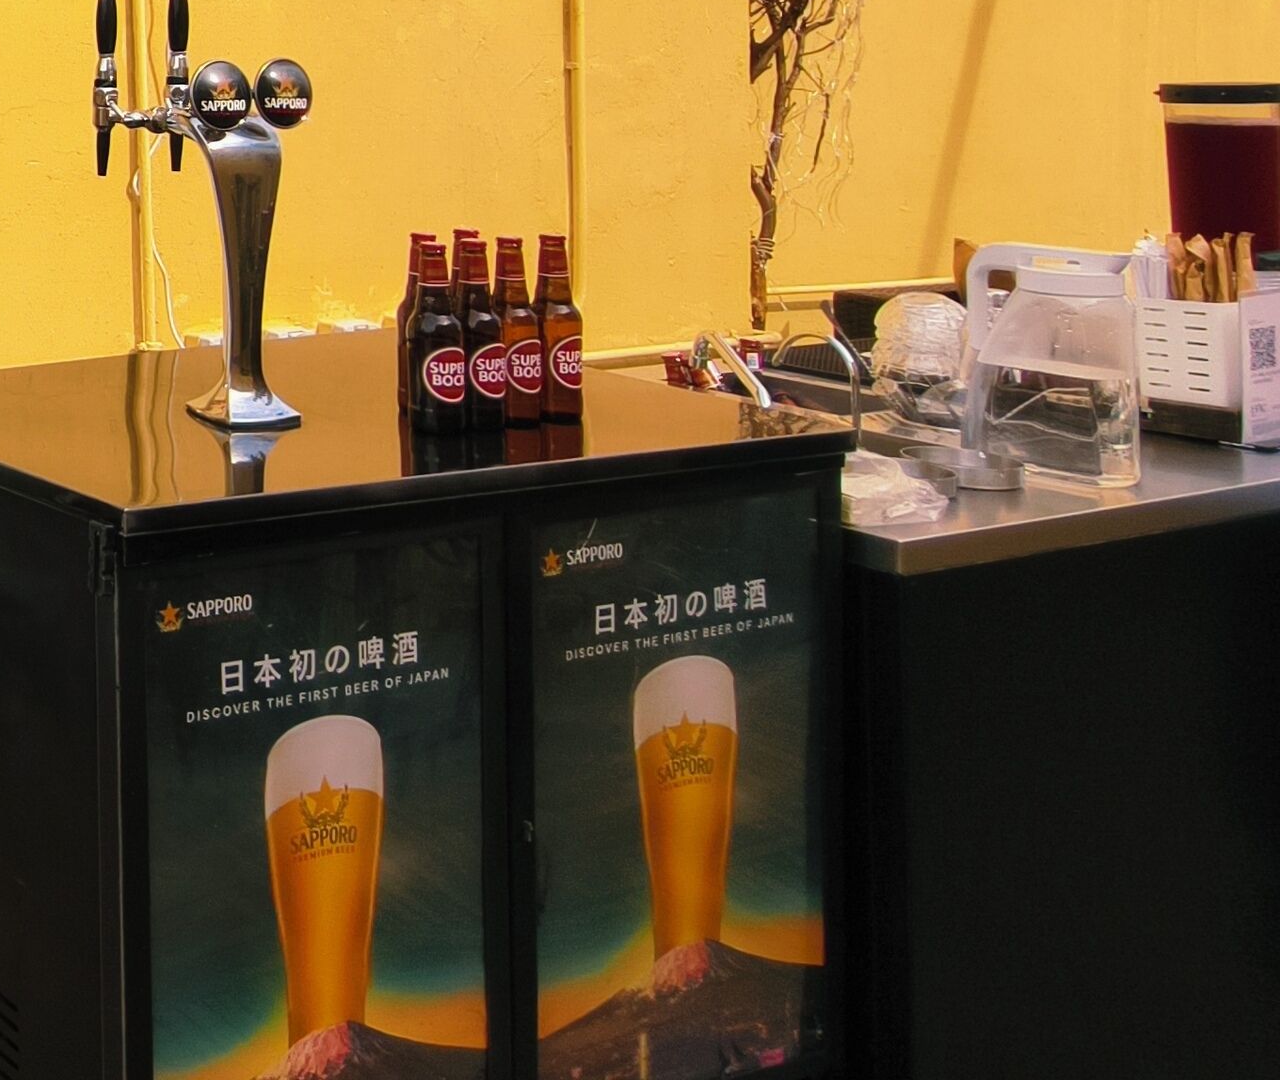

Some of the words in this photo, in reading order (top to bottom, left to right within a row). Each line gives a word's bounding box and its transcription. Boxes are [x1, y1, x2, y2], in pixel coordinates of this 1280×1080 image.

[201, 100, 246, 112] SAPPORO
[264, 97, 307, 110] SAPPORO
[429, 361, 465, 375] SUPE
[475, 358, 507, 370] SUPE
[511, 354, 541, 366] SUPE
[432, 374, 465, 387] BOC
[478, 371, 506, 382] BOC
[513, 366, 541, 378] BOC
[566, 543, 623, 565] SAPPORO
[187, 594, 253, 620] SAPPORO
[595, 578, 767, 635] 日本初の啤酒
[565, 641, 629, 661] DISCOVER
[635, 636, 658, 648] THE
[663, 629, 698, 645] FIRST
[702, 623, 733, 638] BEER
[736, 620, 752, 632] OF
[757, 613, 794, 629] JAPAN
[221, 630, 419, 695] 日本初の啤酒
[186, 700, 260, 723] DISCOVER
[267, 694, 293, 709] THE
[299, 687, 339, 703] FIRST
[345, 680, 379, 696] BEER
[385, 676, 402, 689] OF
[407, 668, 449, 685] JAPAN
[657, 758, 714, 784] SAPPORO
[290, 825, 357, 854] SAPPORO
